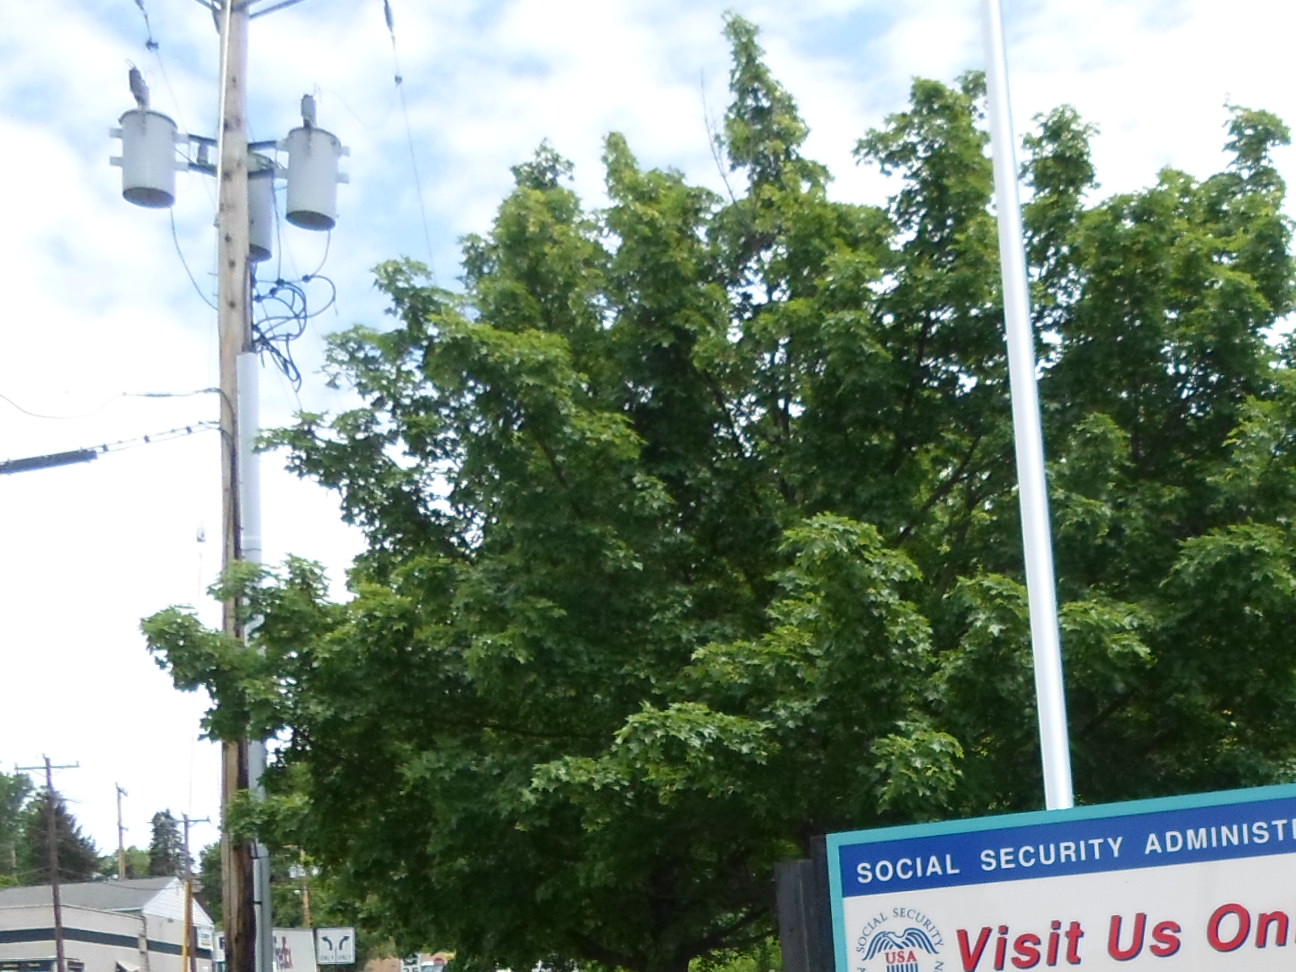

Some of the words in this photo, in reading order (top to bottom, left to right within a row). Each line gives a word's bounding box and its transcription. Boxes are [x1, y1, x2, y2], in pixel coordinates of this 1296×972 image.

[856, 854, 960, 884] SOCIAL
[980, 837, 1123, 871] SECURITY
[856, 912, 888, 953] SOCIAL
[892, 907, 944, 946] SECURITY
[1107, 912, 1181, 961] Us
[885, 950, 918, 964] USA
